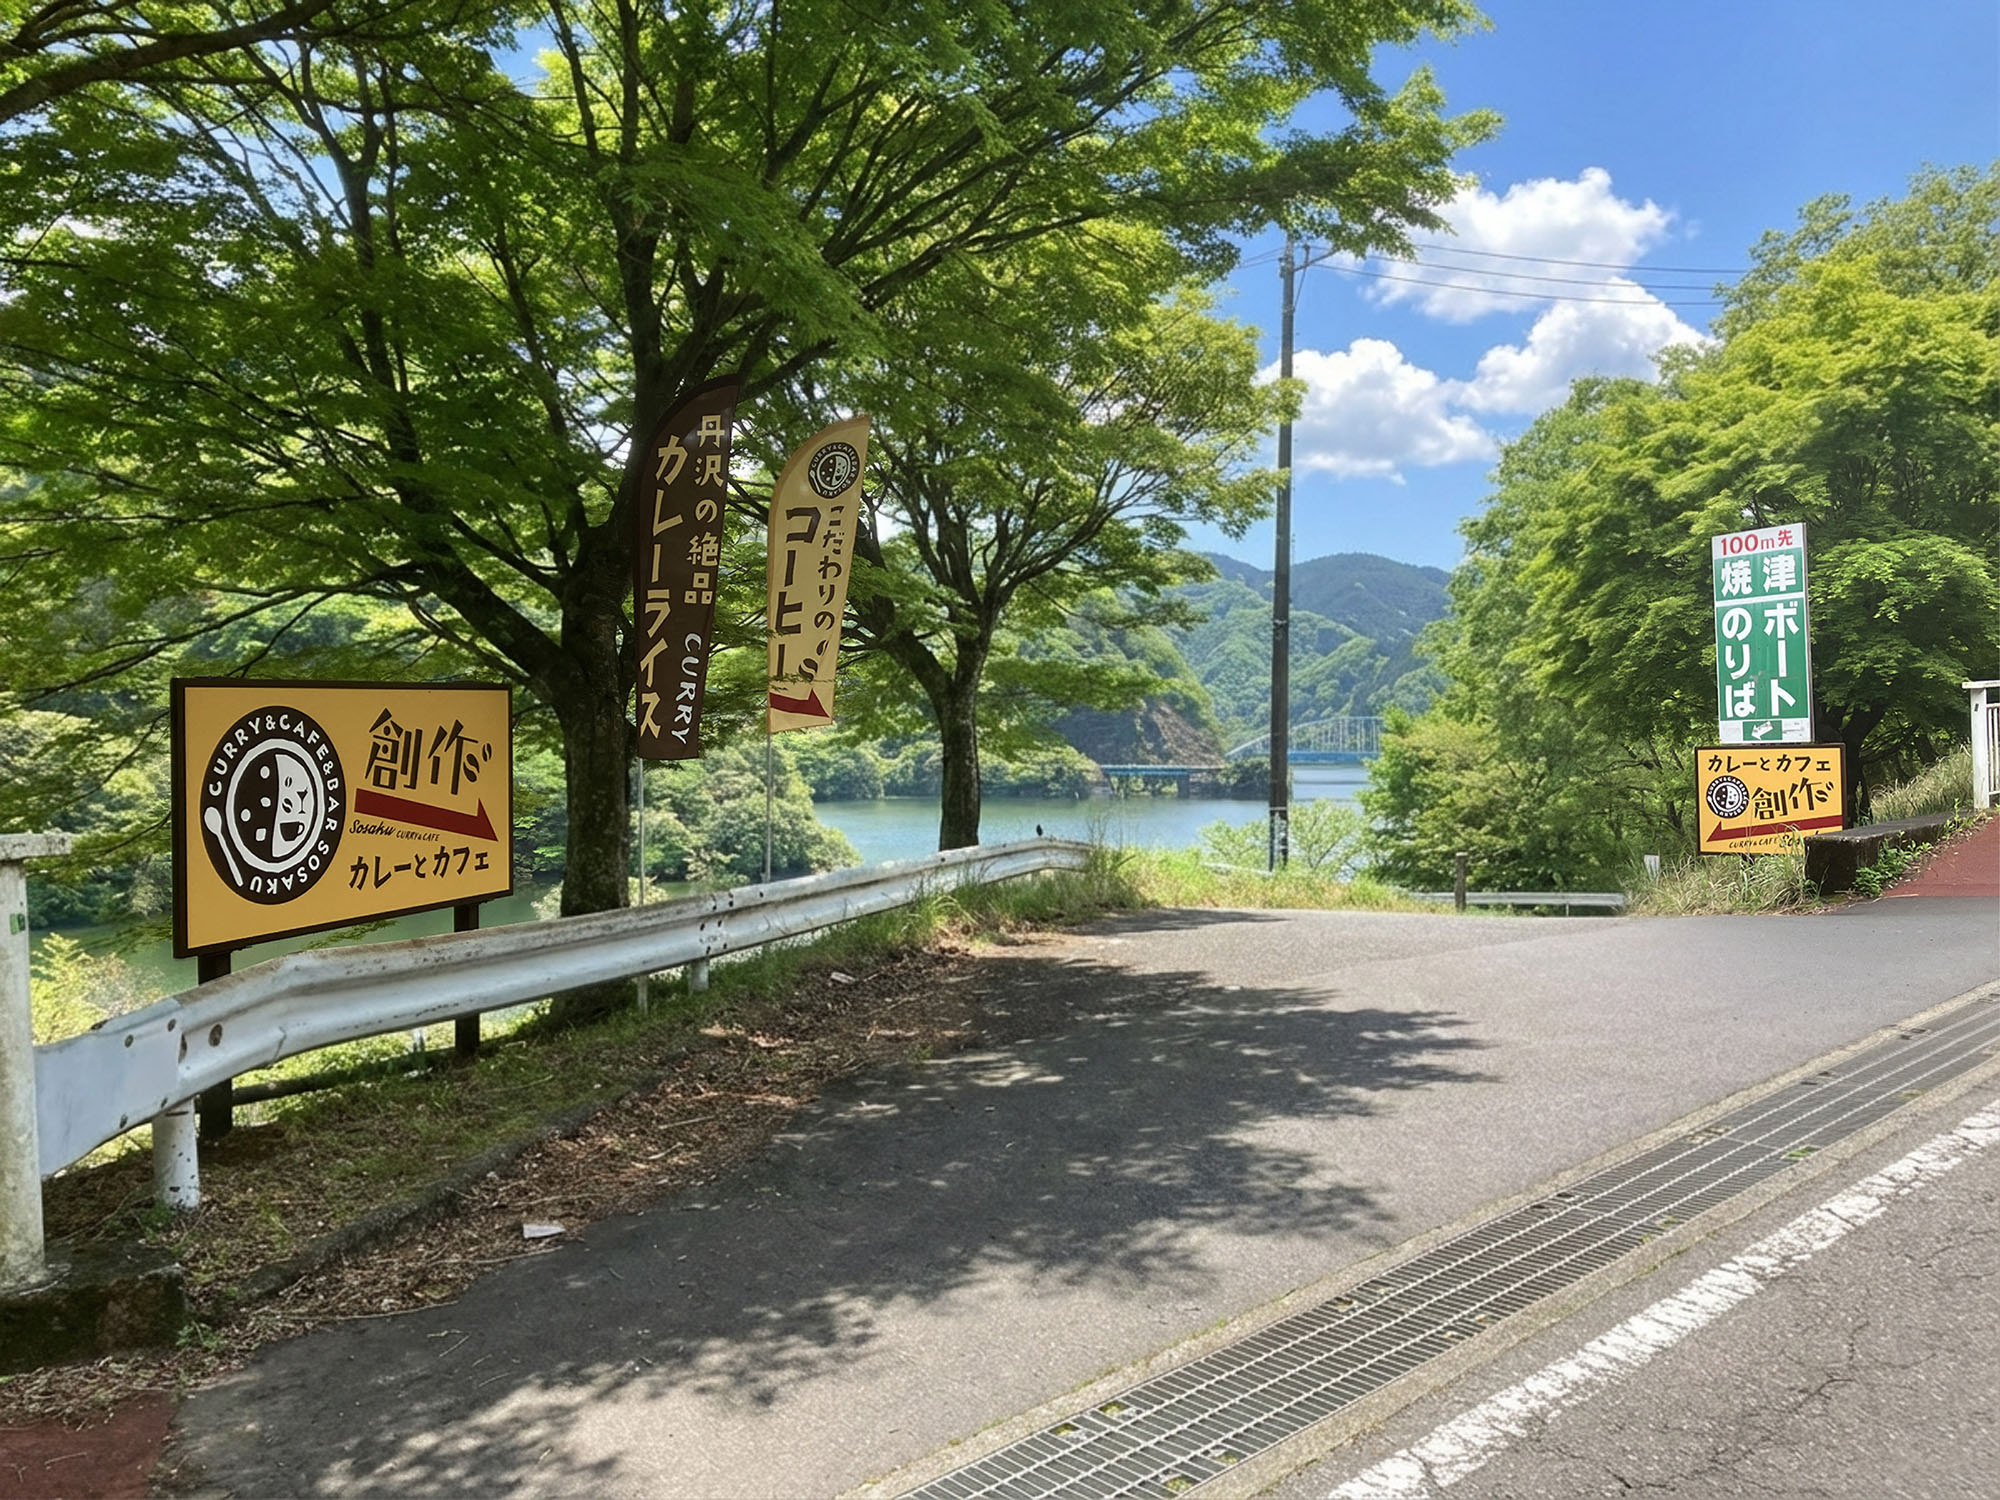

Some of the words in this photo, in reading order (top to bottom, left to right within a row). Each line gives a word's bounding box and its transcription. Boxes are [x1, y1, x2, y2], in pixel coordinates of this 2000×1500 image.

[683, 414, 725, 605] 丹沢の絶品
[1721, 529, 1793, 556] 100m先
[639, 434, 688, 739] カレーライス
[774, 506, 821, 677] コーヒー
[813, 505, 845, 631] こだわりの
[671, 632, 702, 745] CURRY
[1721, 607, 1756, 719] のりば
[1763, 600, 1800, 716] ボート
[365, 707, 493, 795] 創作
[1708, 754, 1831, 773] カレーとカフェ
[1751, 777, 1834, 820] 創作
[249, 840, 330, 895] SOSAKU
[349, 819, 396, 836] Sosaku
[349, 845, 490, 891] カレーとカフェ
